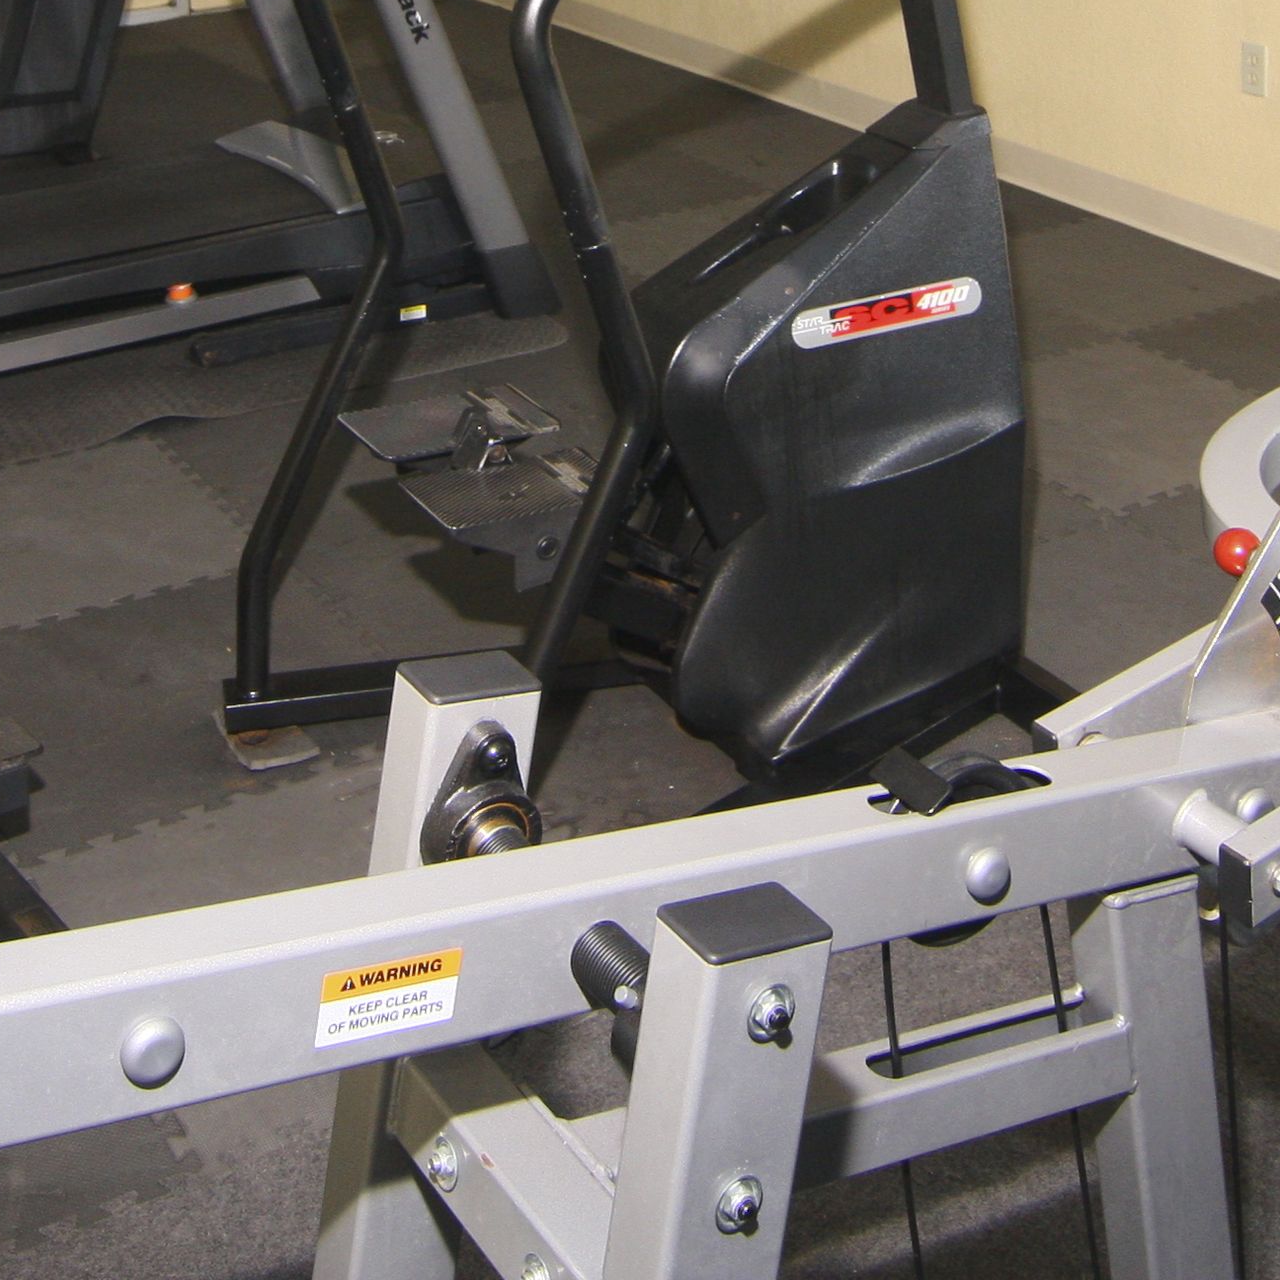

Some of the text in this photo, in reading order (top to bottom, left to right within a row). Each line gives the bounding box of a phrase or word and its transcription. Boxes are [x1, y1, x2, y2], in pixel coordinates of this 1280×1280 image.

[916, 285, 970, 310] 4100
[796, 315, 824, 330] STAR
[820, 320, 852, 336] TRAC
[359, 958, 443, 987] WARNING
[348, 990, 428, 1016] KEEP CLEAR
[327, 1000, 444, 1035] OF MOVING PARTS
